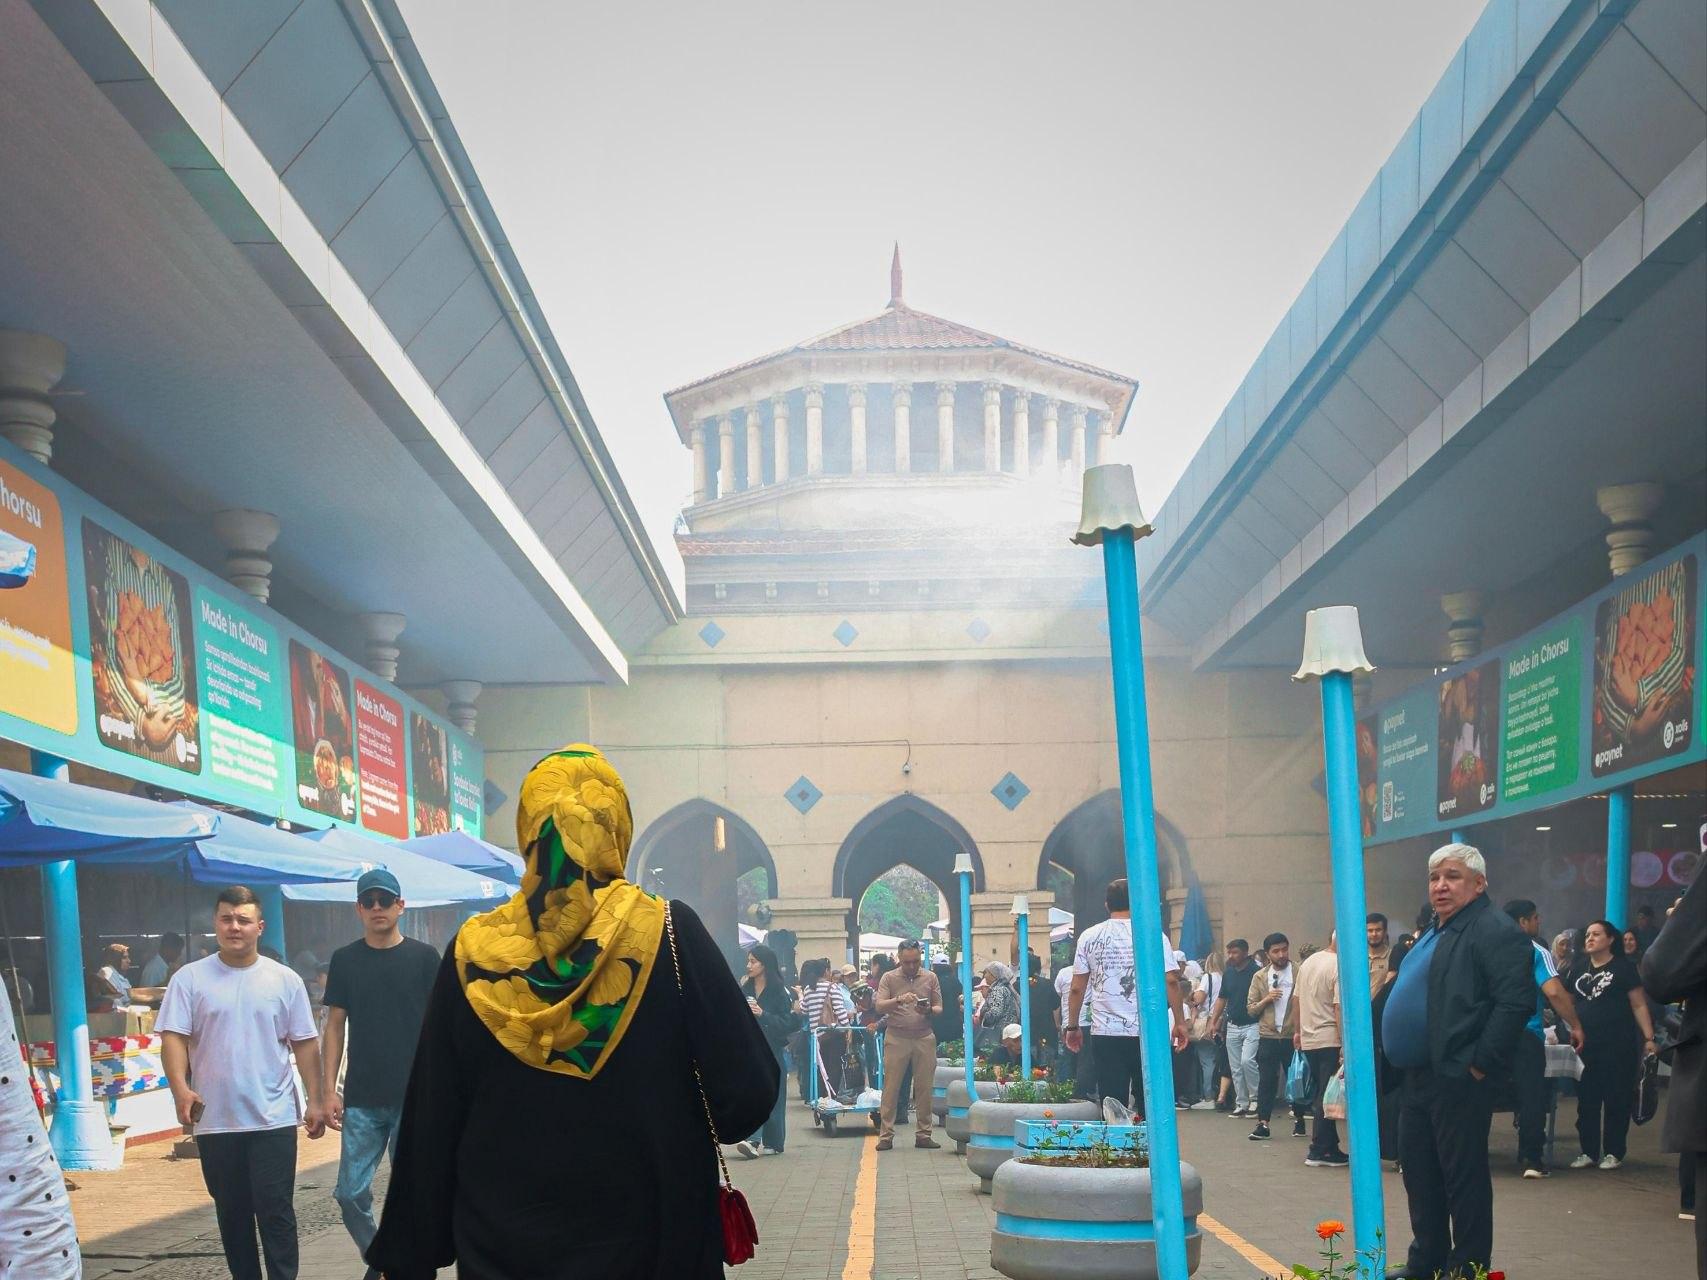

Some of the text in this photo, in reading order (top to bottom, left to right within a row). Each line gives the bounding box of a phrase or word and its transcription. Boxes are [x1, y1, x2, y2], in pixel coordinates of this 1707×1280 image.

[202, 600, 267, 655] Made in Chorsu
[1508, 637, 1569, 679] Made in Chorsu
[1600, 743, 1623, 768] paynet
